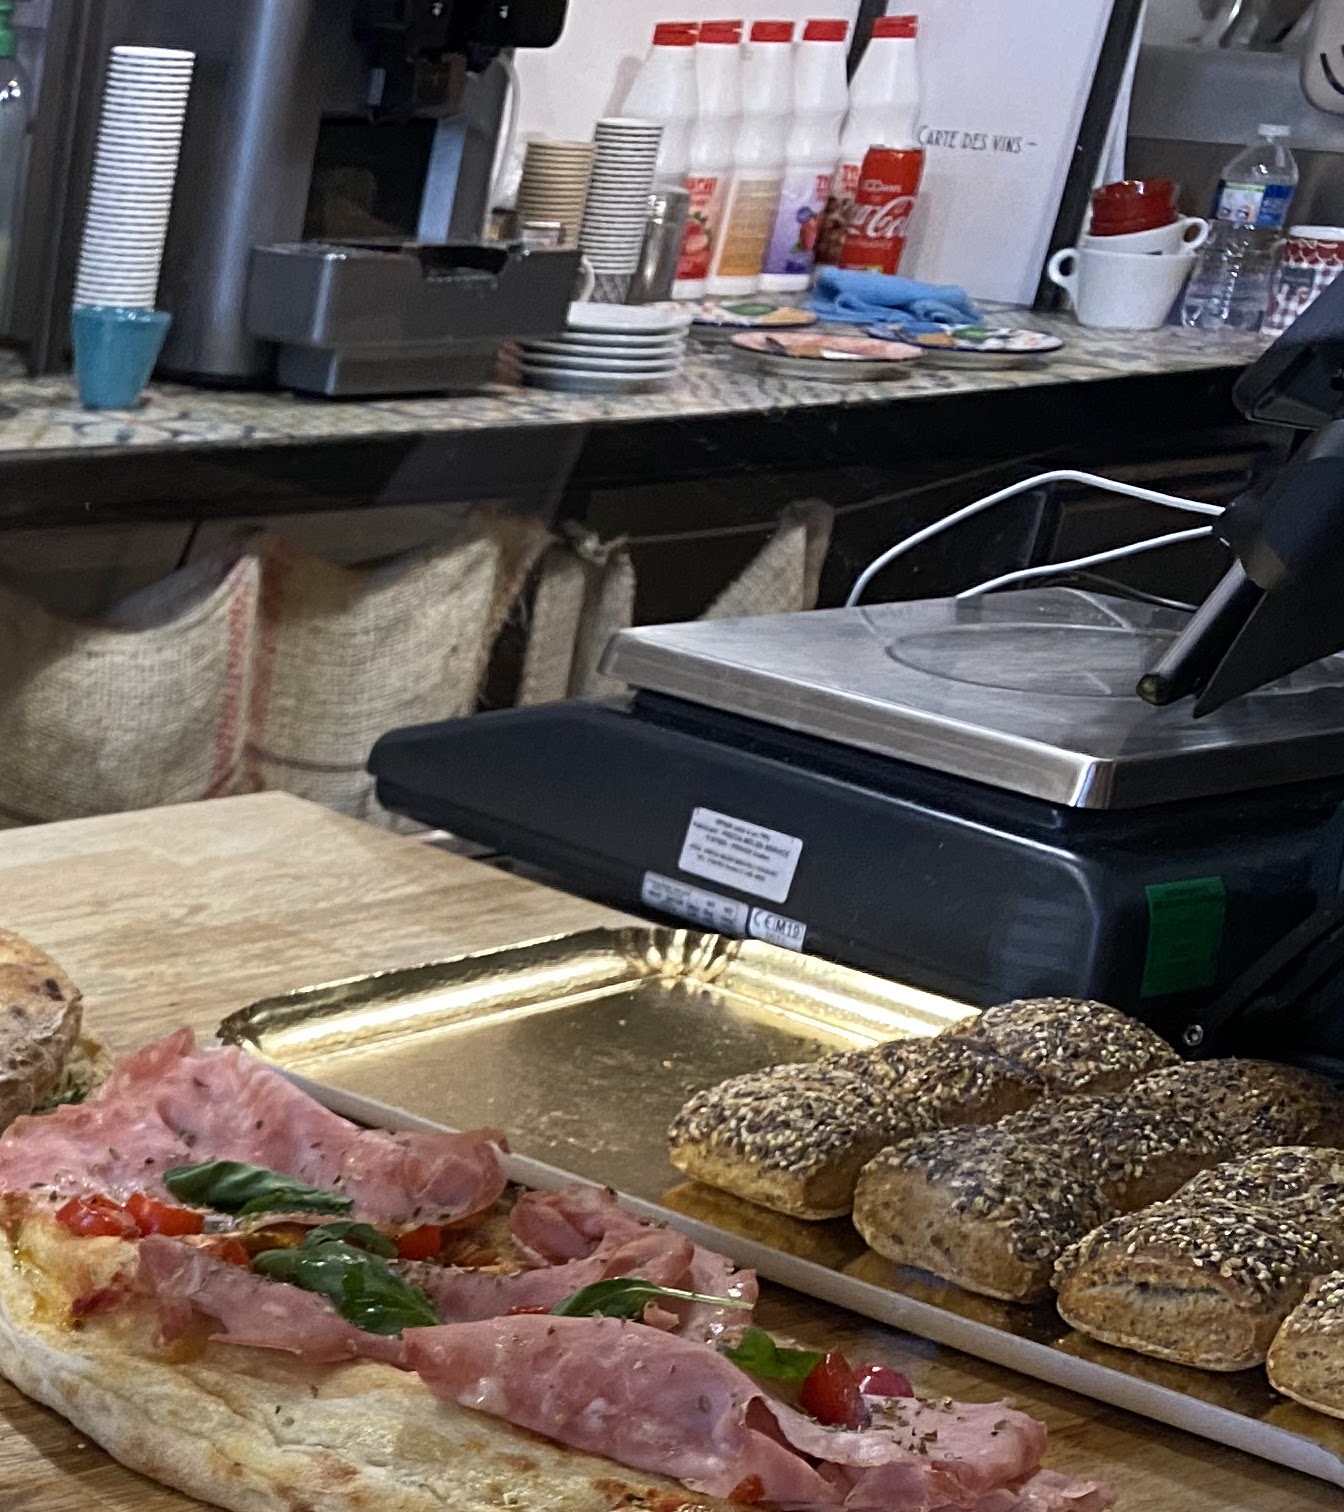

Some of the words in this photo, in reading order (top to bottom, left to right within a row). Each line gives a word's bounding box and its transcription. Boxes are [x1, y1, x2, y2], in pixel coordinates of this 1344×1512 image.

[917, 125, 958, 149] CARTE
[960, 132, 987, 151] DES
[992, 134, 1023, 153] VINS
